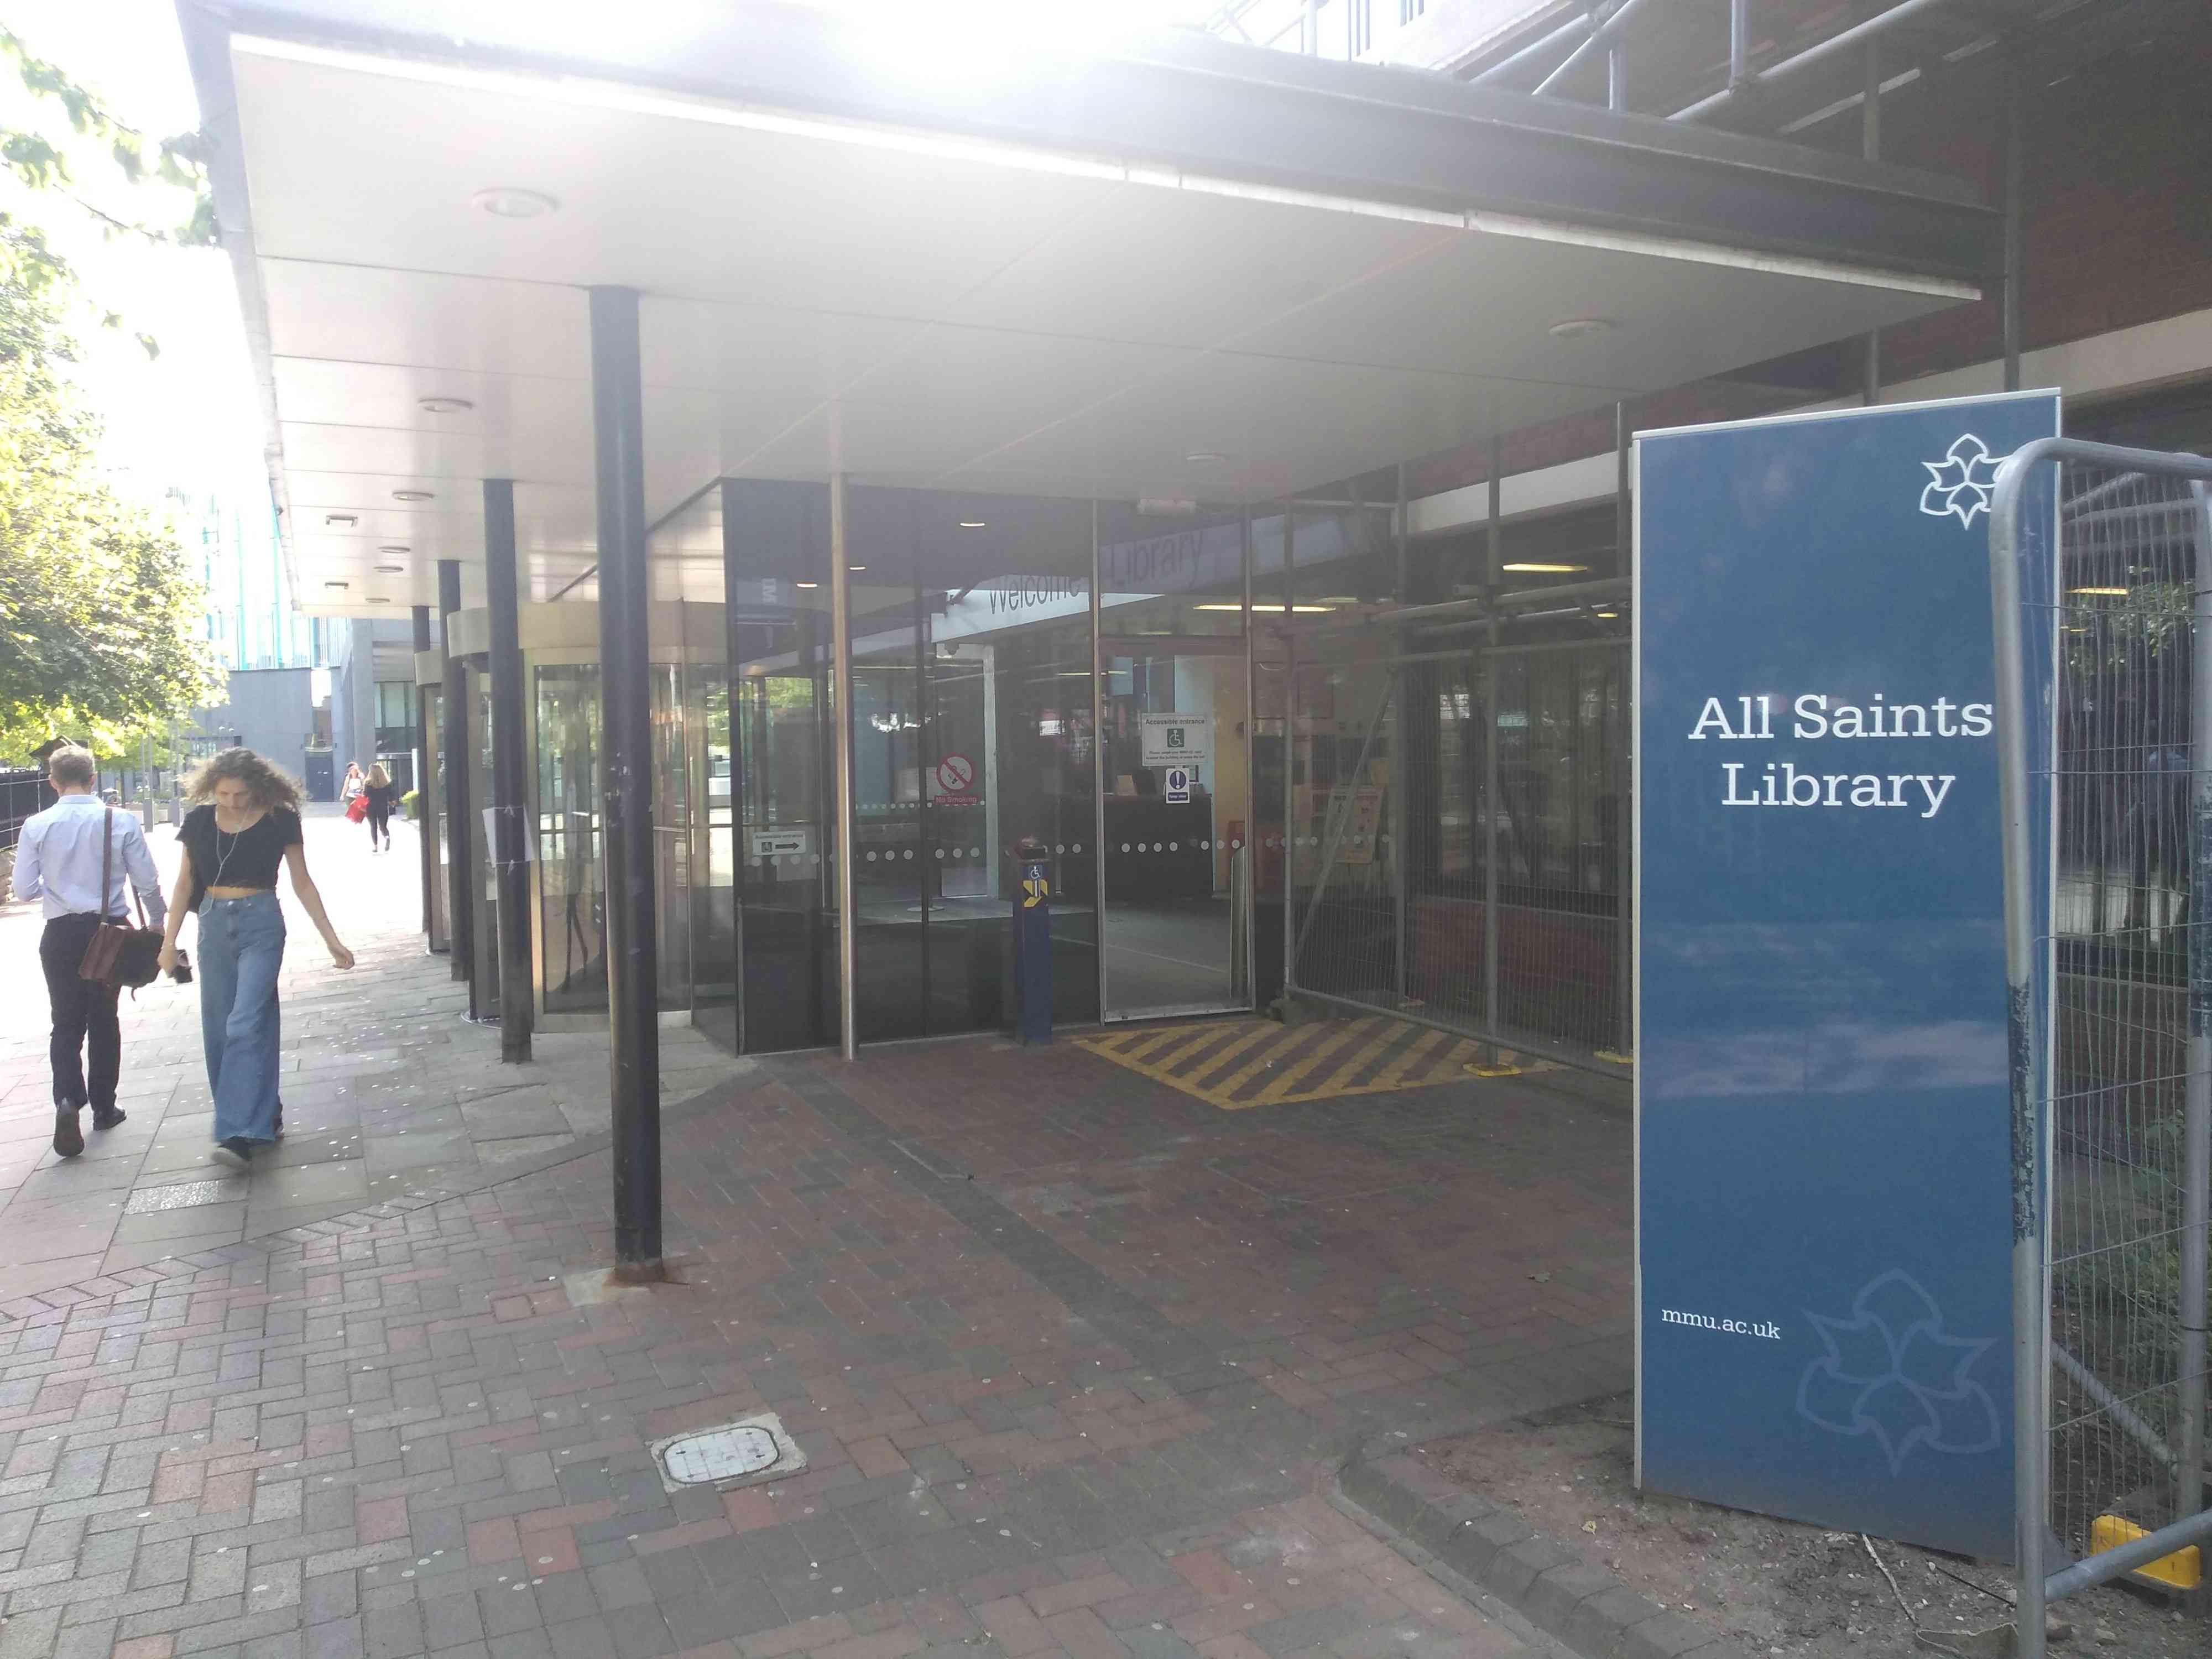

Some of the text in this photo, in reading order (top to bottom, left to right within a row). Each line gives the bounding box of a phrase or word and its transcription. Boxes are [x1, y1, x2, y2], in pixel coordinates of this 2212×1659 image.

[1688, 693, 1993, 739] All Saints
[1721, 763, 1956, 818] Library
[1661, 1309, 1781, 1339] mmu.ac.uk
